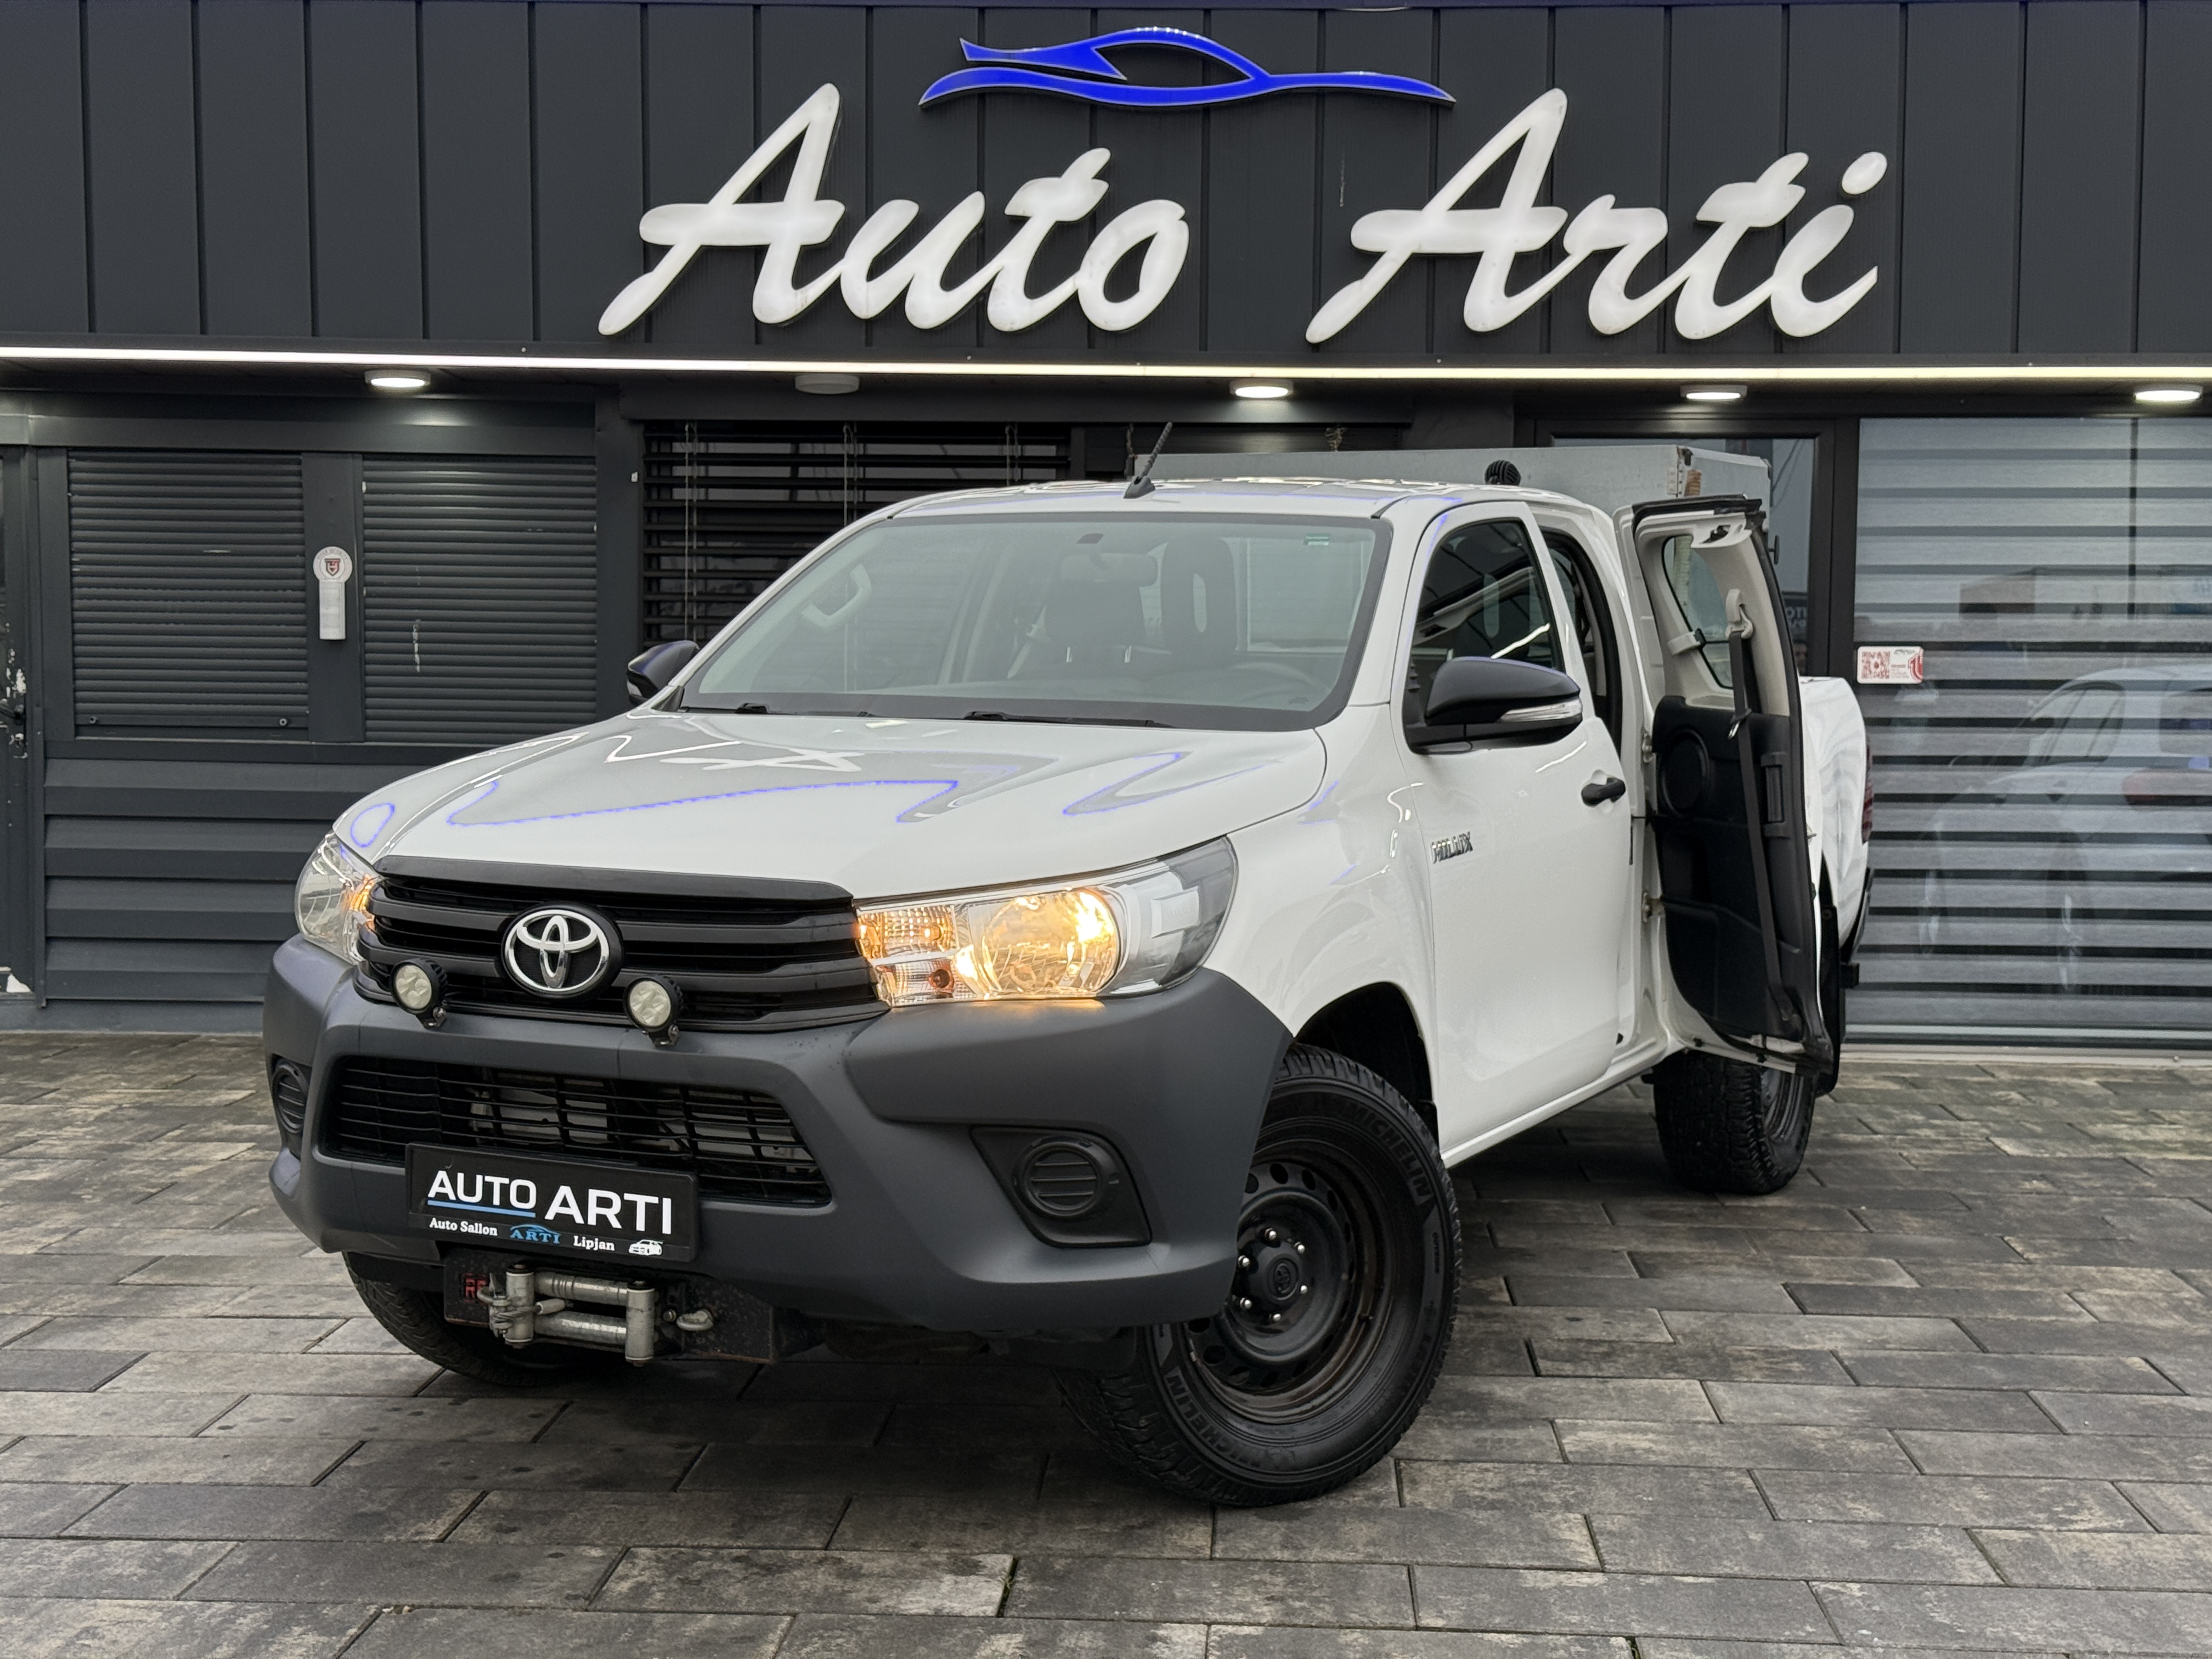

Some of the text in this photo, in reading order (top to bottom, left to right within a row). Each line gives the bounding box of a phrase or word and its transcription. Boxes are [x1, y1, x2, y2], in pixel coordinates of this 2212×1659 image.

[598, 83, 1887, 343] Auto Arti
[1344, 1099, 1435, 1198] MICHELIN
[427, 1170, 672, 1234] AUTO ARTI
[430, 1217, 616, 1251] Auto Sallon ARTI Lipjan
